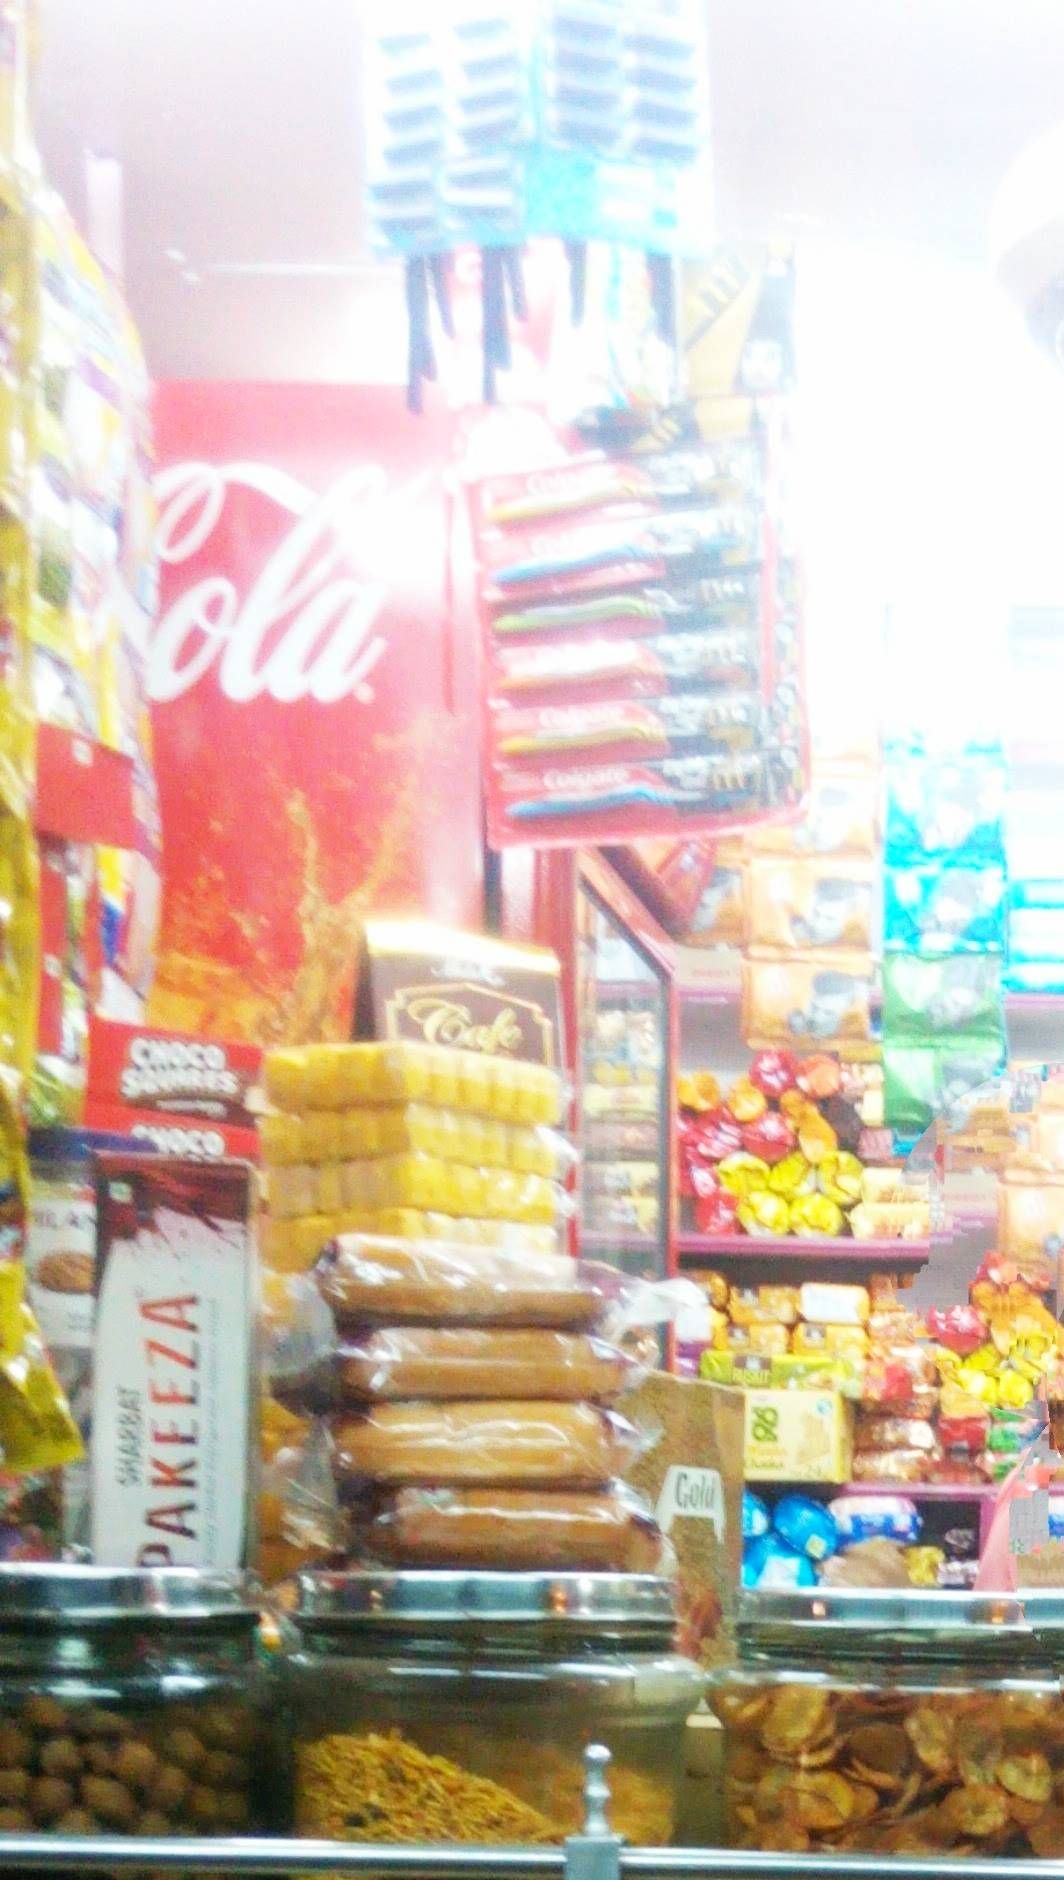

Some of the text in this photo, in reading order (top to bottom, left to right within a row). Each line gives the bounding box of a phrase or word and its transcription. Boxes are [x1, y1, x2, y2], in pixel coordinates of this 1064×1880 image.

[543, 765, 630, 791] Colgate
[131, 1037, 227, 1070] CHOCO
[136, 1293, 200, 1567] PAKEEZA
[673, 1471, 716, 1509] Gold
